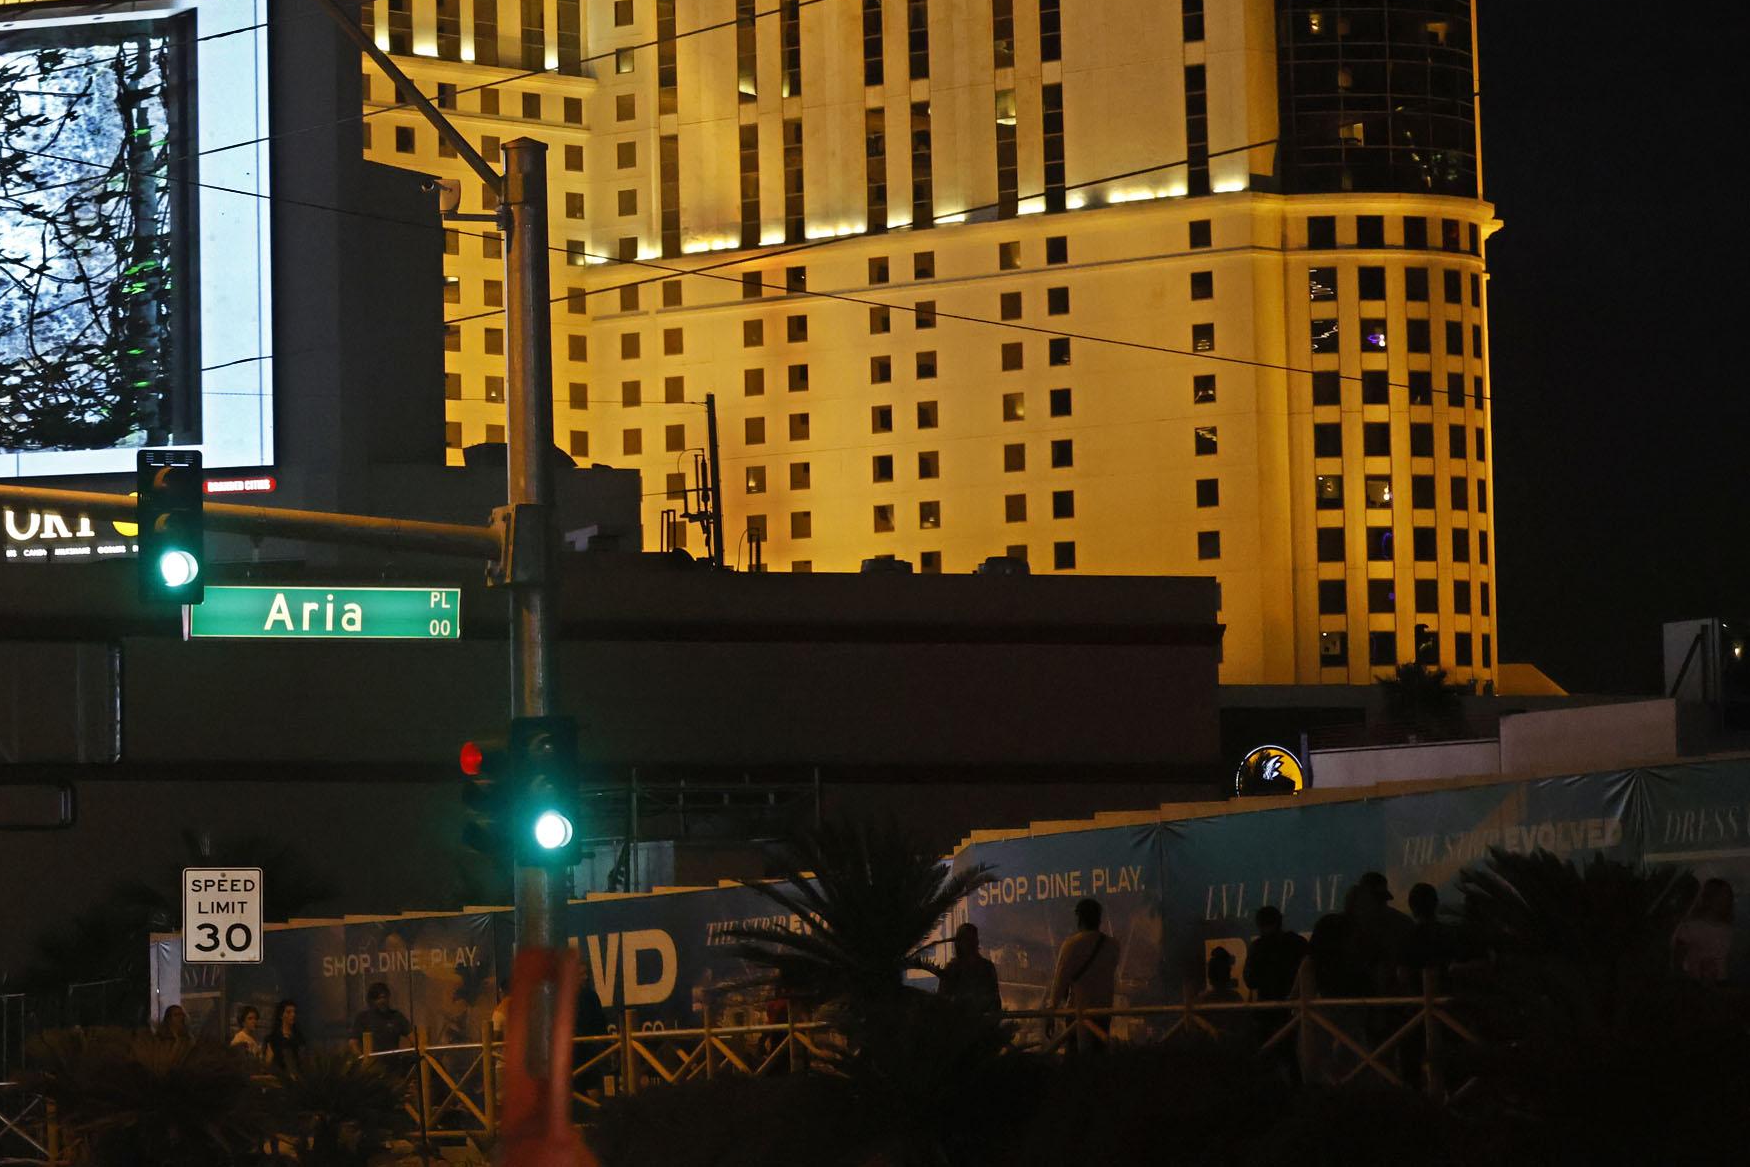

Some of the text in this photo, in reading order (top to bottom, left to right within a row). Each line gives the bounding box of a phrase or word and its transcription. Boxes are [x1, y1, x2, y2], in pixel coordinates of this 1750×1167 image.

[264, 592, 451, 632] Aria PL
[429, 619, 451, 636] 00
[191, 879, 255, 893] SPEED
[978, 865, 1145, 906] SHOP. DINE. PLAY.
[198, 901, 248, 914] LIMIT
[194, 922, 252, 952] 30
[323, 945, 481, 978] SHOP. DINE. PLAY.
